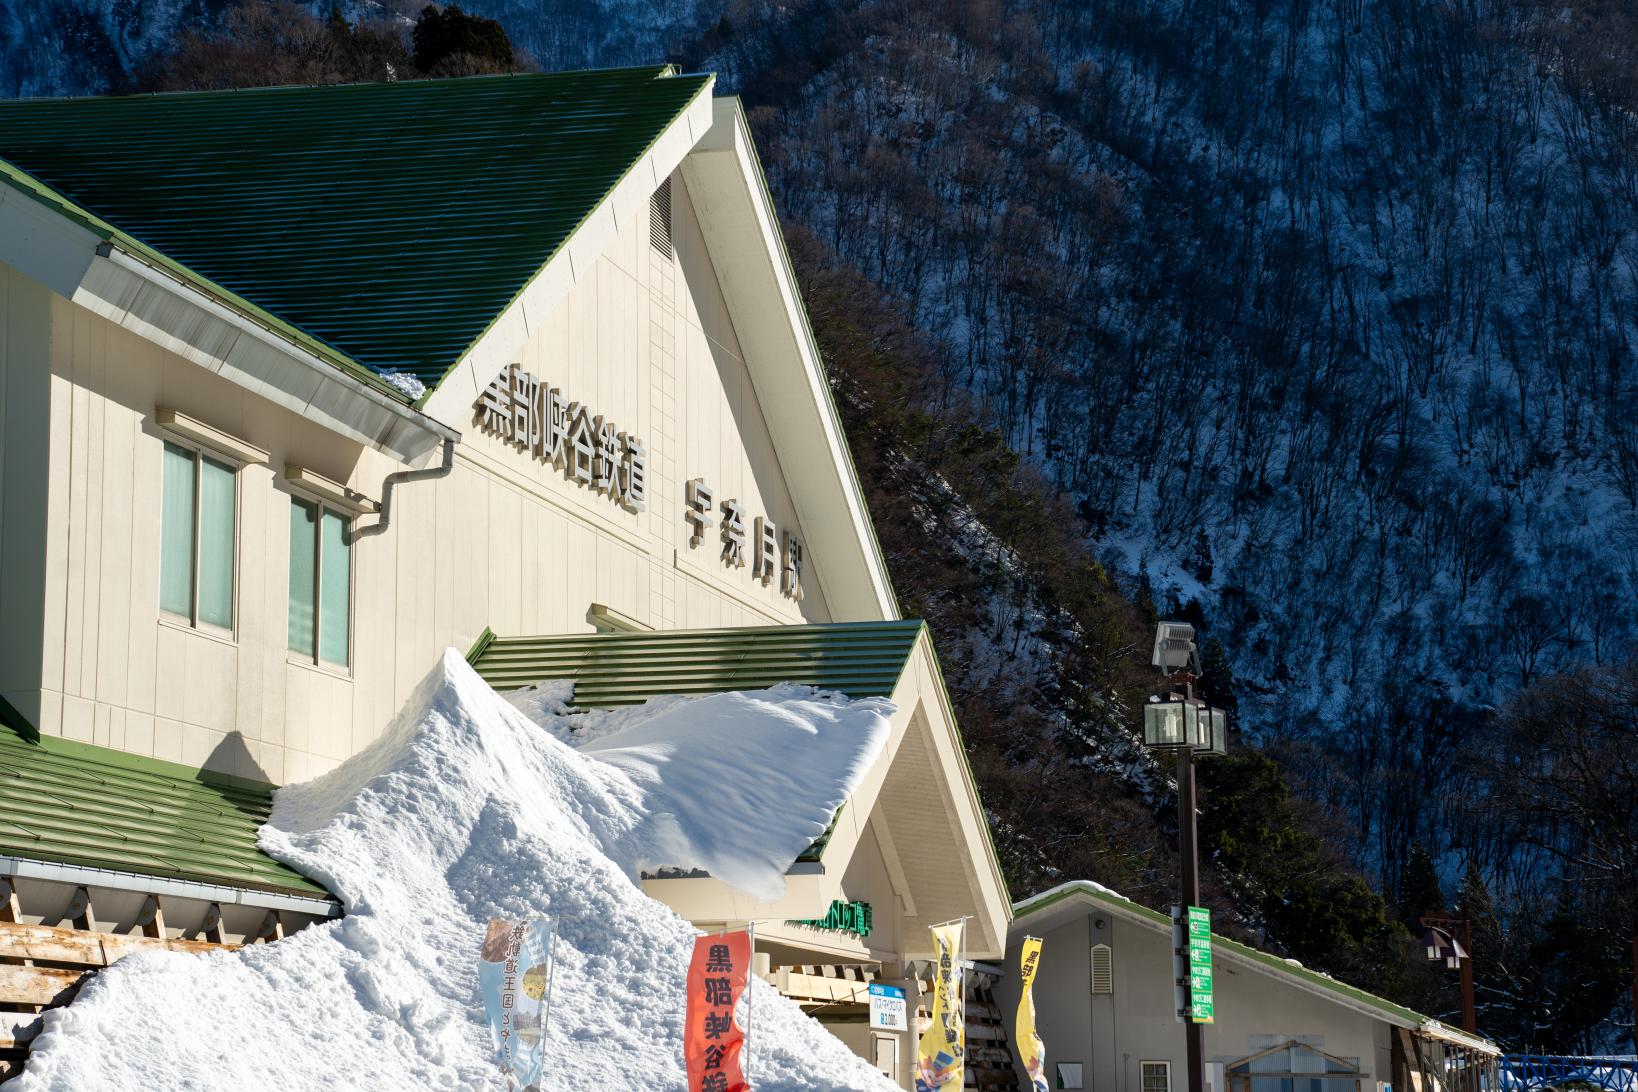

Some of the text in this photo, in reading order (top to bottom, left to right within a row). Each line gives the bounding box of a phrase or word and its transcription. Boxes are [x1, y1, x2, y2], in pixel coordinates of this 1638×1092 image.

[473, 363, 804, 602] 黒部峡谷鉄道 宇奈月駅
